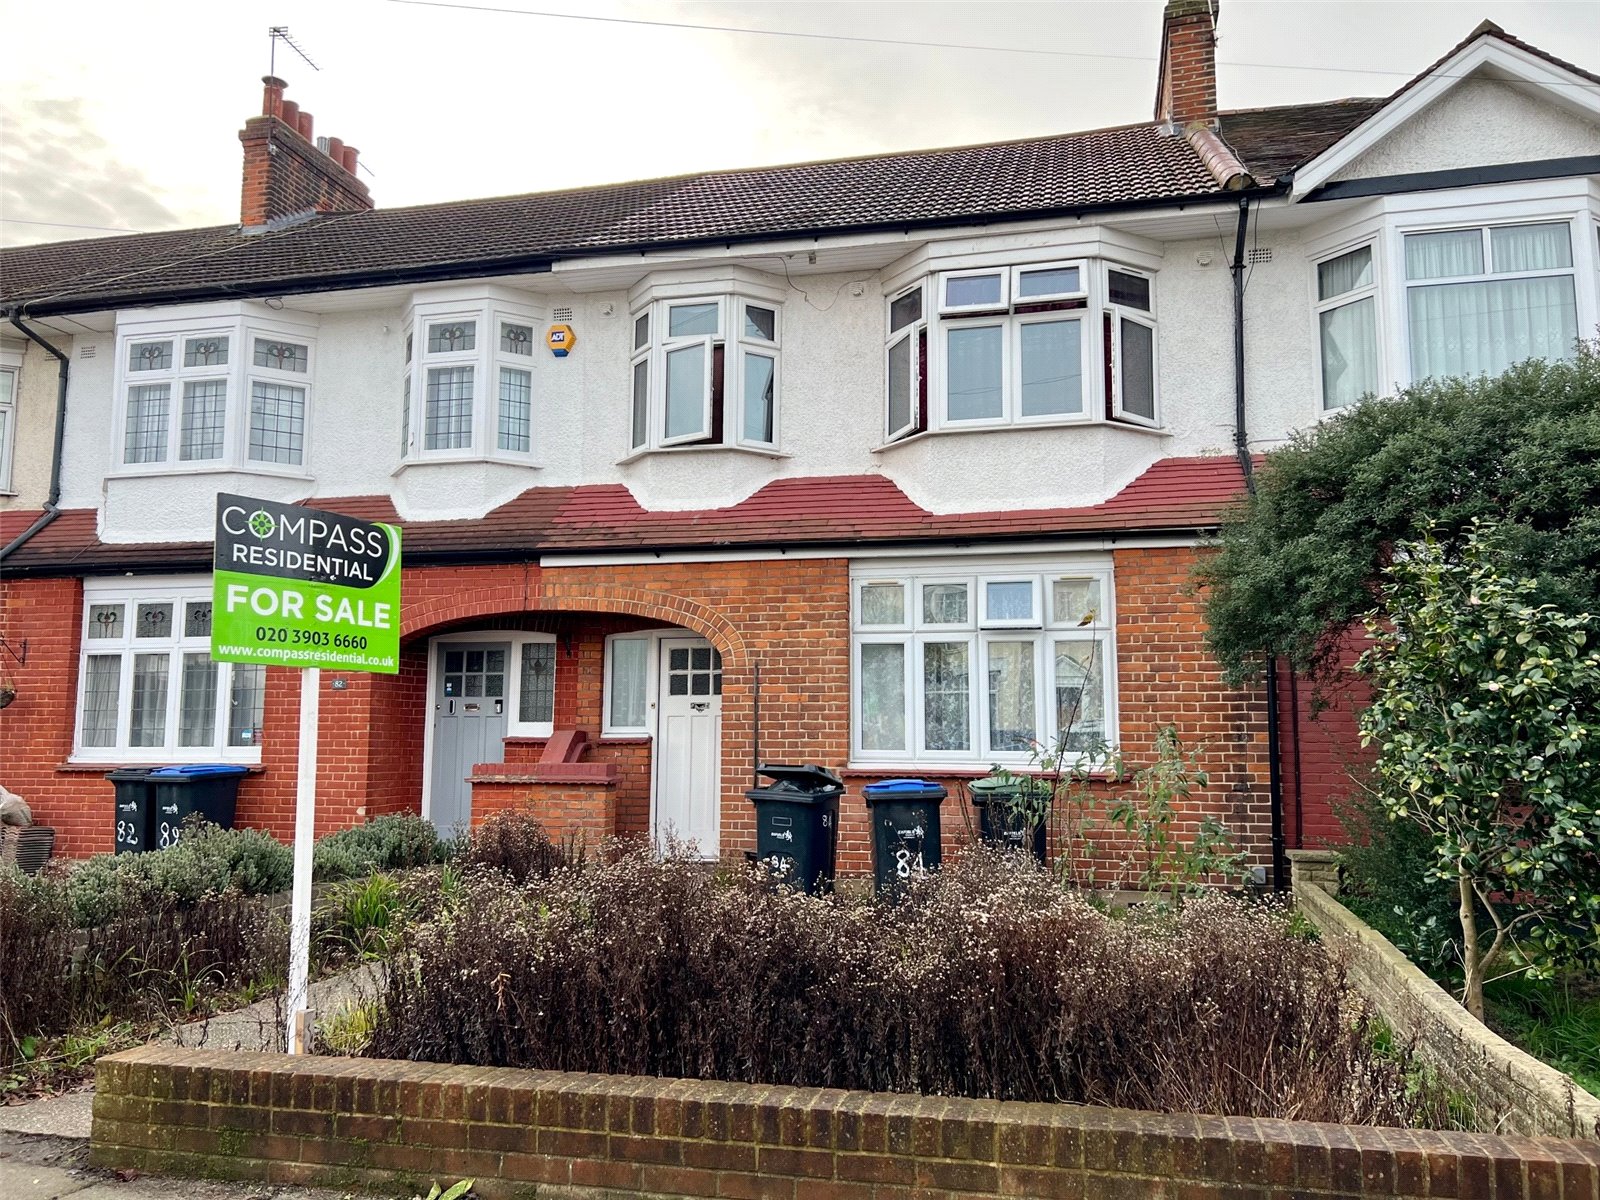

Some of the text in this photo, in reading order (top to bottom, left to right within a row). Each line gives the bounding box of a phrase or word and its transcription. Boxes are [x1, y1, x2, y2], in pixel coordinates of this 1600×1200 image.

[552, 332, 564, 341] ADT
[222, 506, 382, 558] COMPASS
[233, 543, 373, 581] RESIDENTIAL
[227, 584, 391, 629] FOR SALE
[256, 626, 368, 650] 020 3903 6660
[218, 644, 394, 667] www.compassresidential.co.uk
[117, 820, 138, 845] 82
